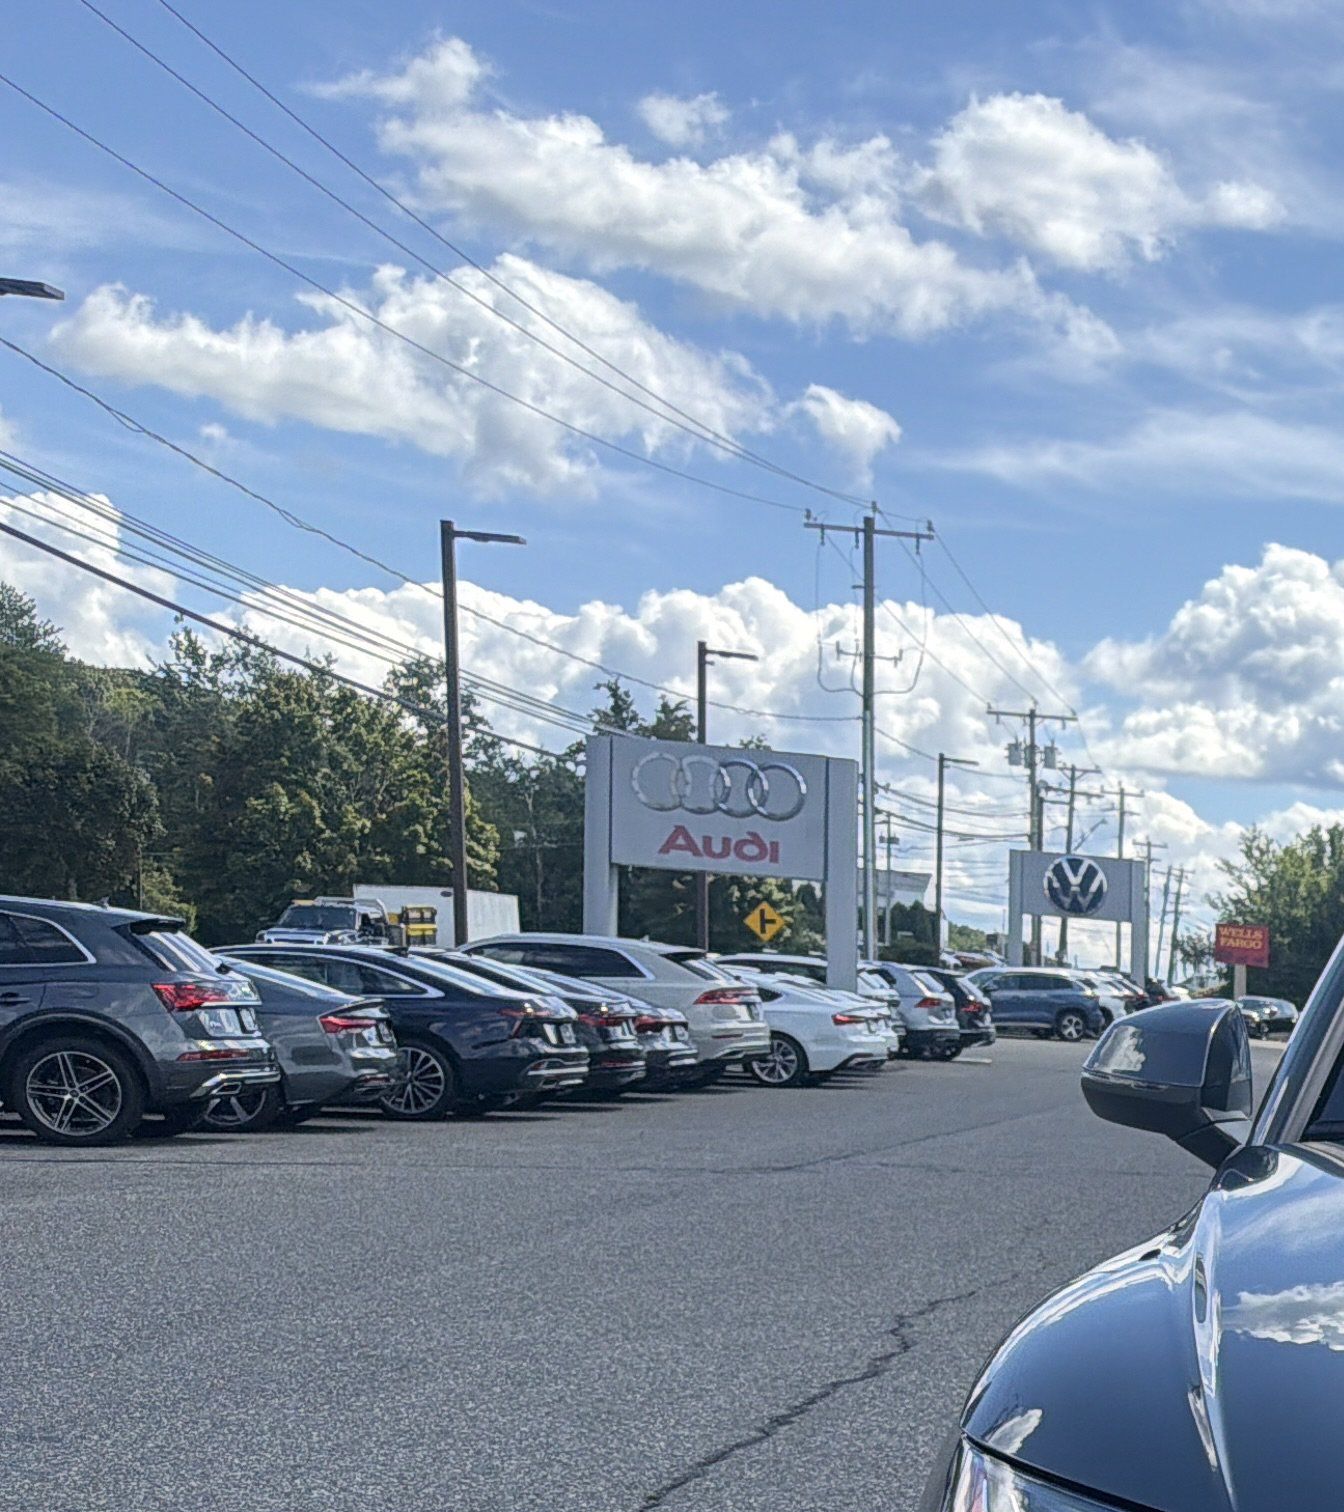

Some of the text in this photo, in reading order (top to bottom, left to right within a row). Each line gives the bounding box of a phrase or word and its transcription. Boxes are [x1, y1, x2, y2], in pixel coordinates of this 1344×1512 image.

[657, 825, 780, 863] Audi
[1218, 926, 1263, 940] WELLS
[1220, 937, 1262, 950] FARGO
